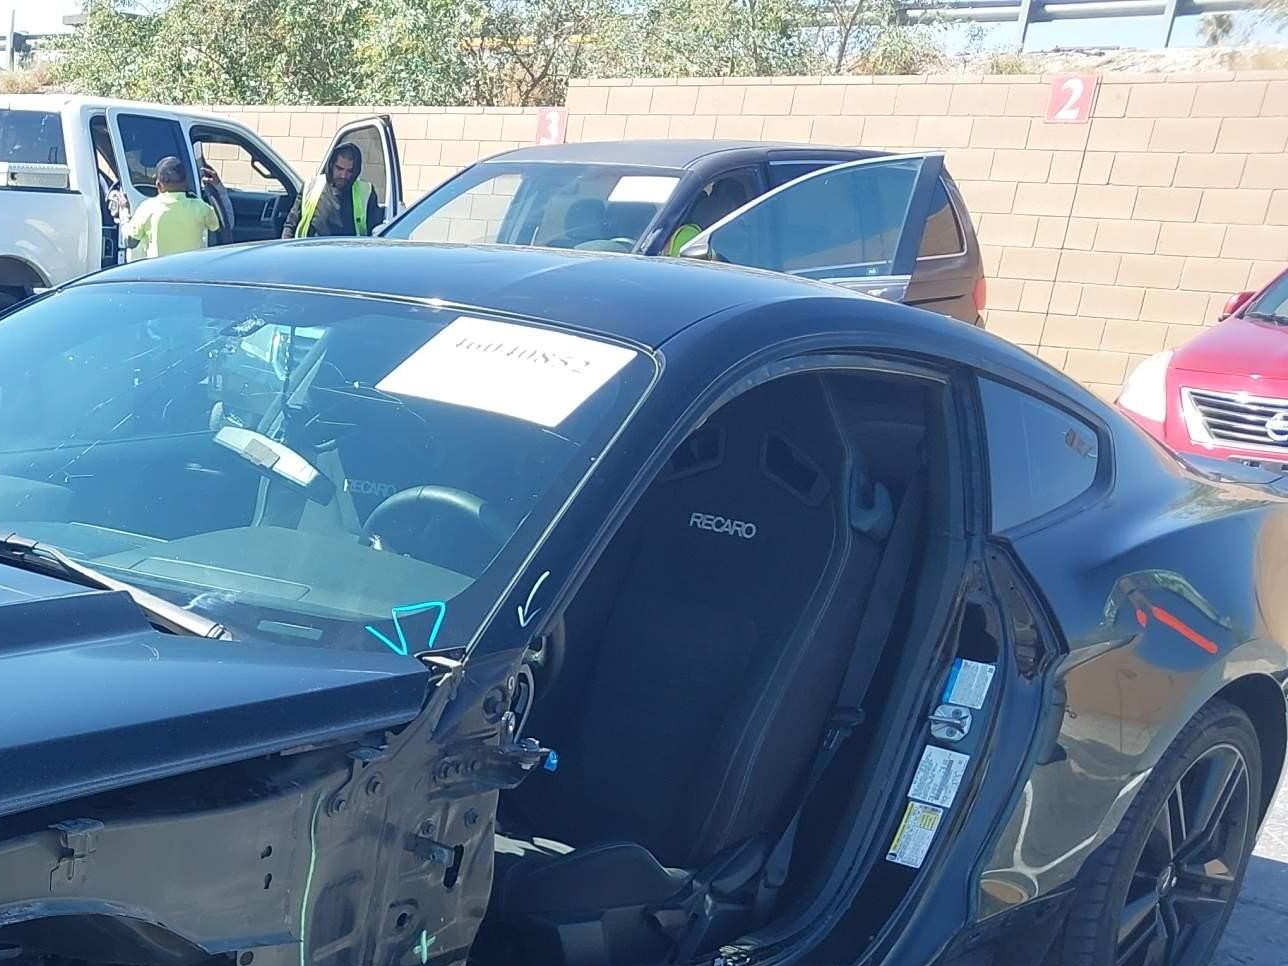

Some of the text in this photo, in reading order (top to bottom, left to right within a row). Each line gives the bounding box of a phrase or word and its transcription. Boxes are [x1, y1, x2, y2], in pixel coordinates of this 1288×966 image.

[1053, 78, 1083, 120] 2
[539, 110, 560, 145] 3
[689, 512, 757, 539] RECARO
